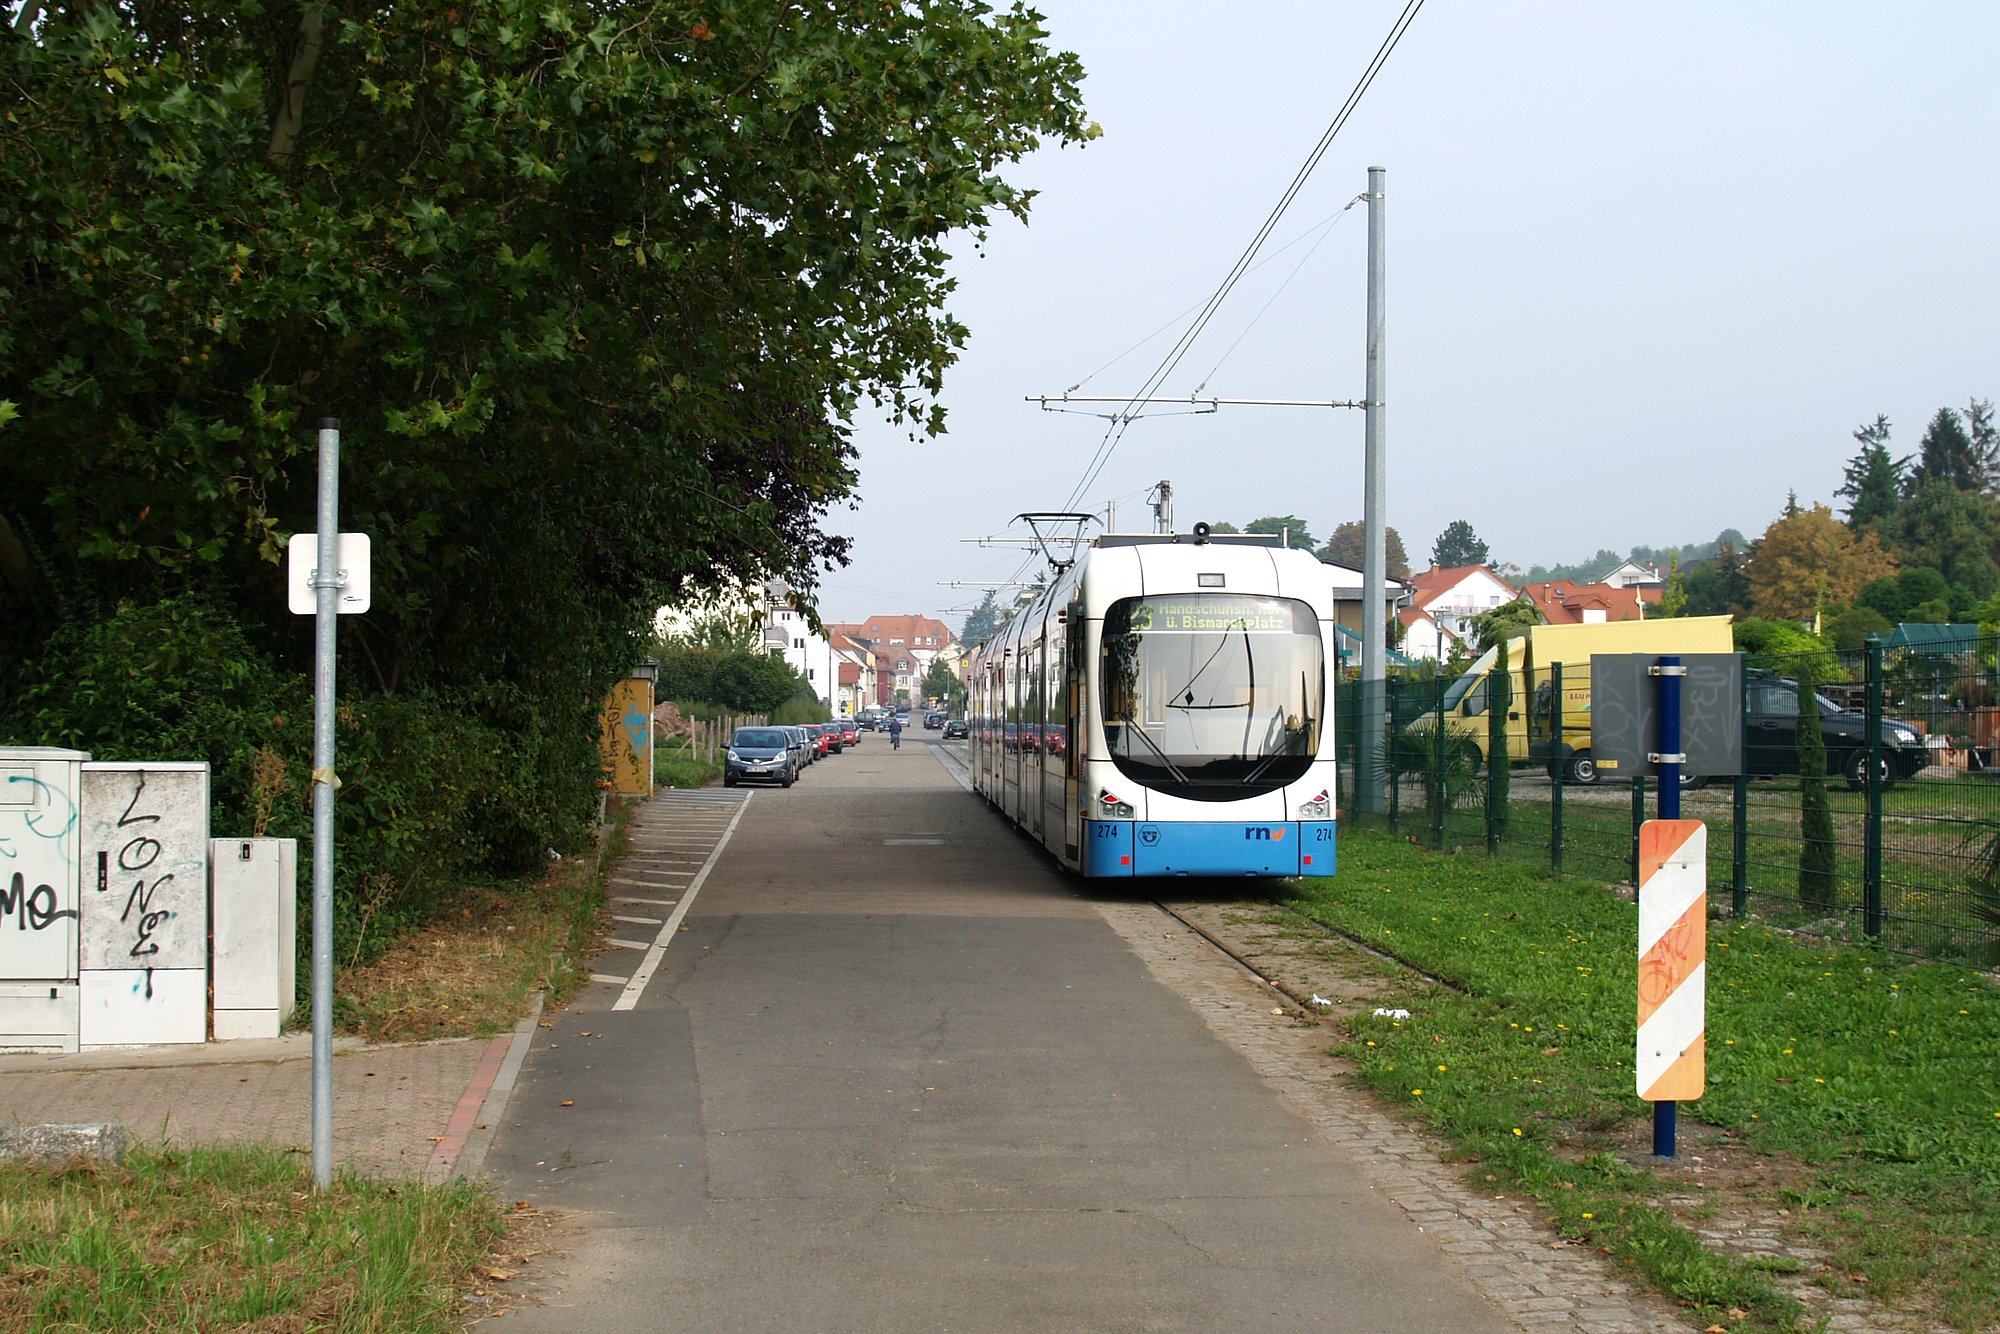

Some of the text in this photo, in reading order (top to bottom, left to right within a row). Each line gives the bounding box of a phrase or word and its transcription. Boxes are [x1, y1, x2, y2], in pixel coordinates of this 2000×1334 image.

[1166, 616, 1178, 628] ü.
[1098, 825, 1118, 838] 274
[1245, 827, 1285, 841] rnv
[1316, 828, 1332, 842] 274
